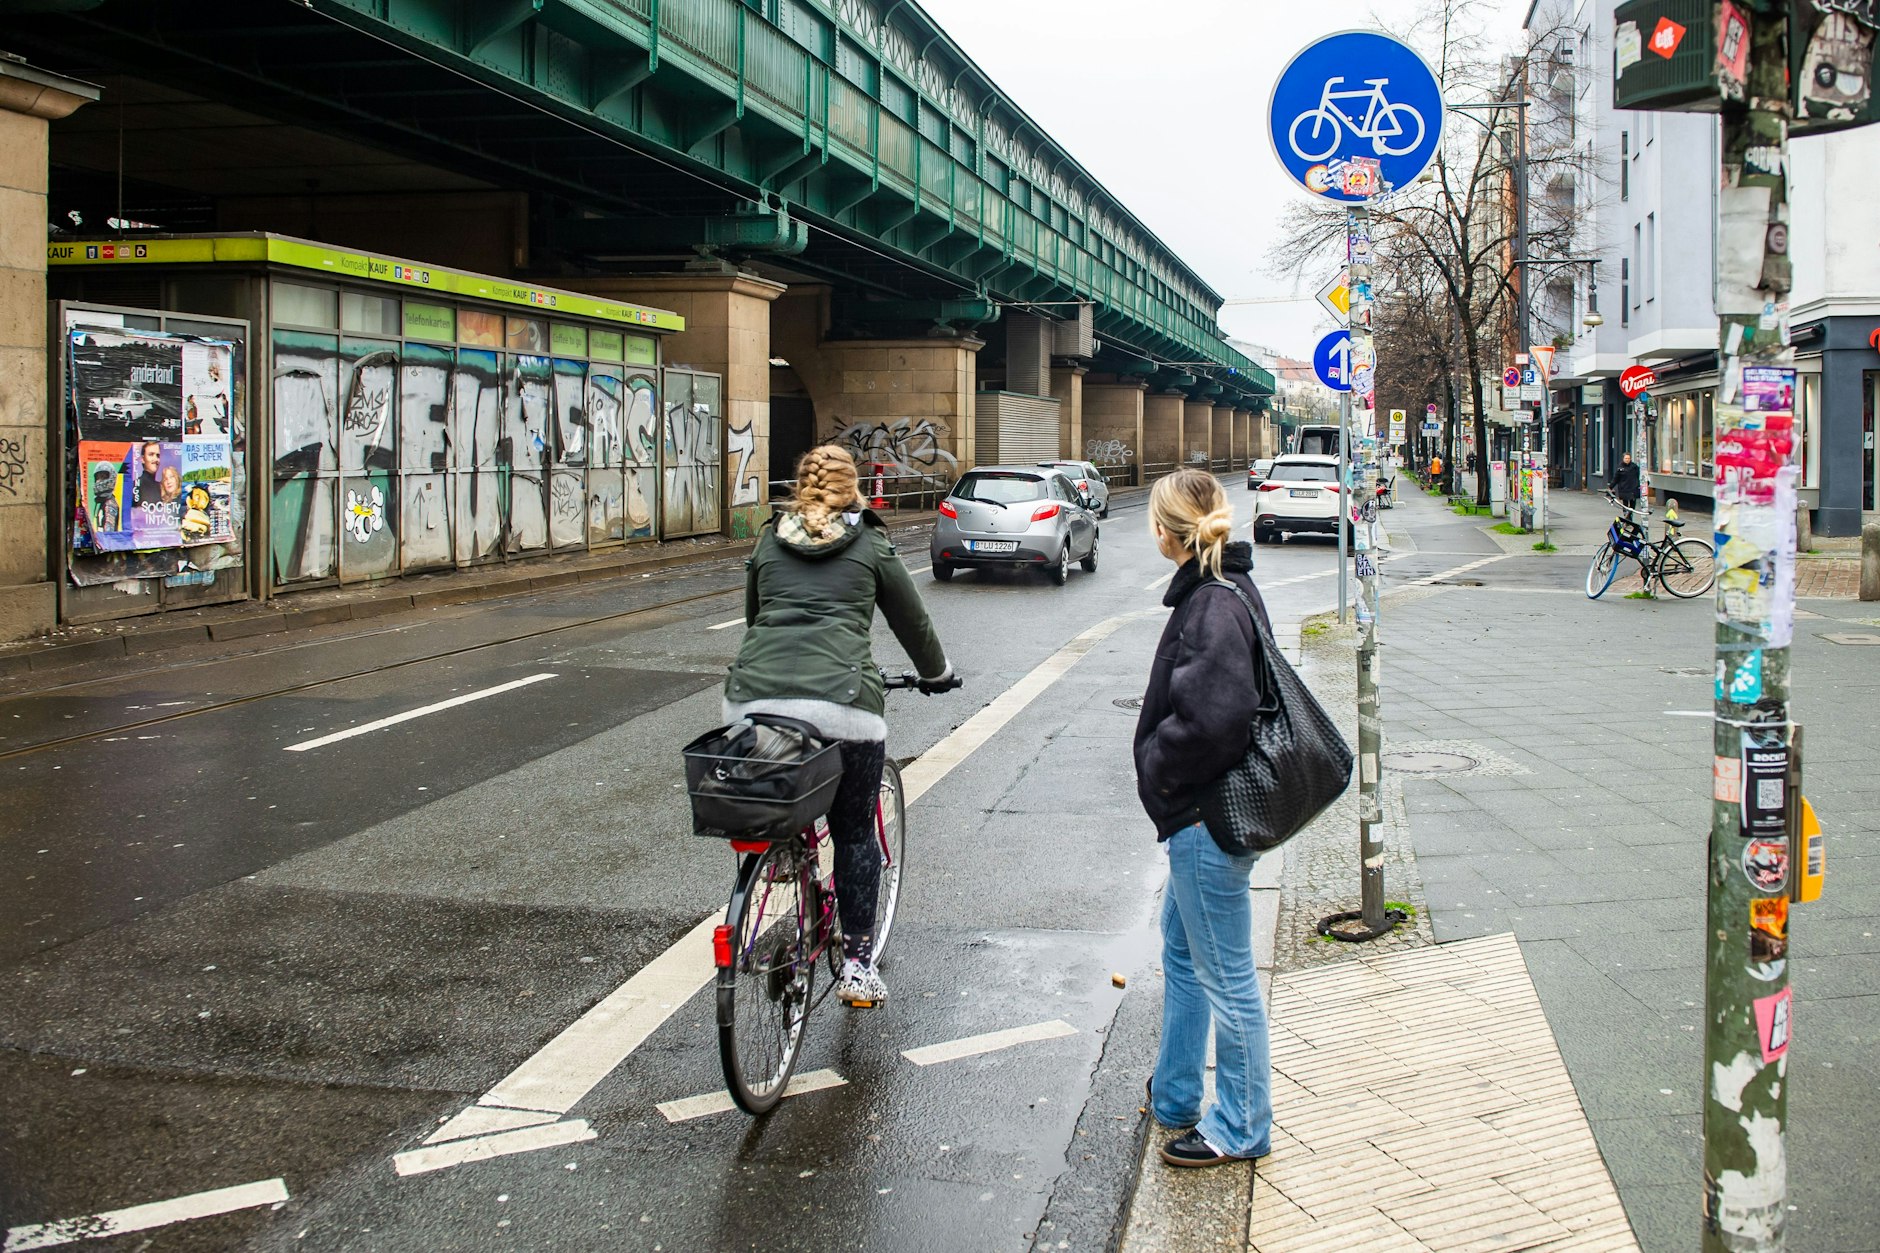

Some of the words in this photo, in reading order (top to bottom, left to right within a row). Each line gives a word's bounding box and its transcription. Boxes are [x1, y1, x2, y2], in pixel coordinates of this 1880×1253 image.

[341, 257, 368, 272] Kompakt
[369, 261, 388, 275] KAUF
[492, 285, 512, 299] Kompakt
[513, 289, 527, 300] KAUF
[404, 312, 451, 330] Telefonkarten
[621, 309, 633, 319] KAUF
[131, 364, 174, 384] anderland
[141, 501, 181, 514] SOCIETY
[145, 513, 181, 527] INTACT
